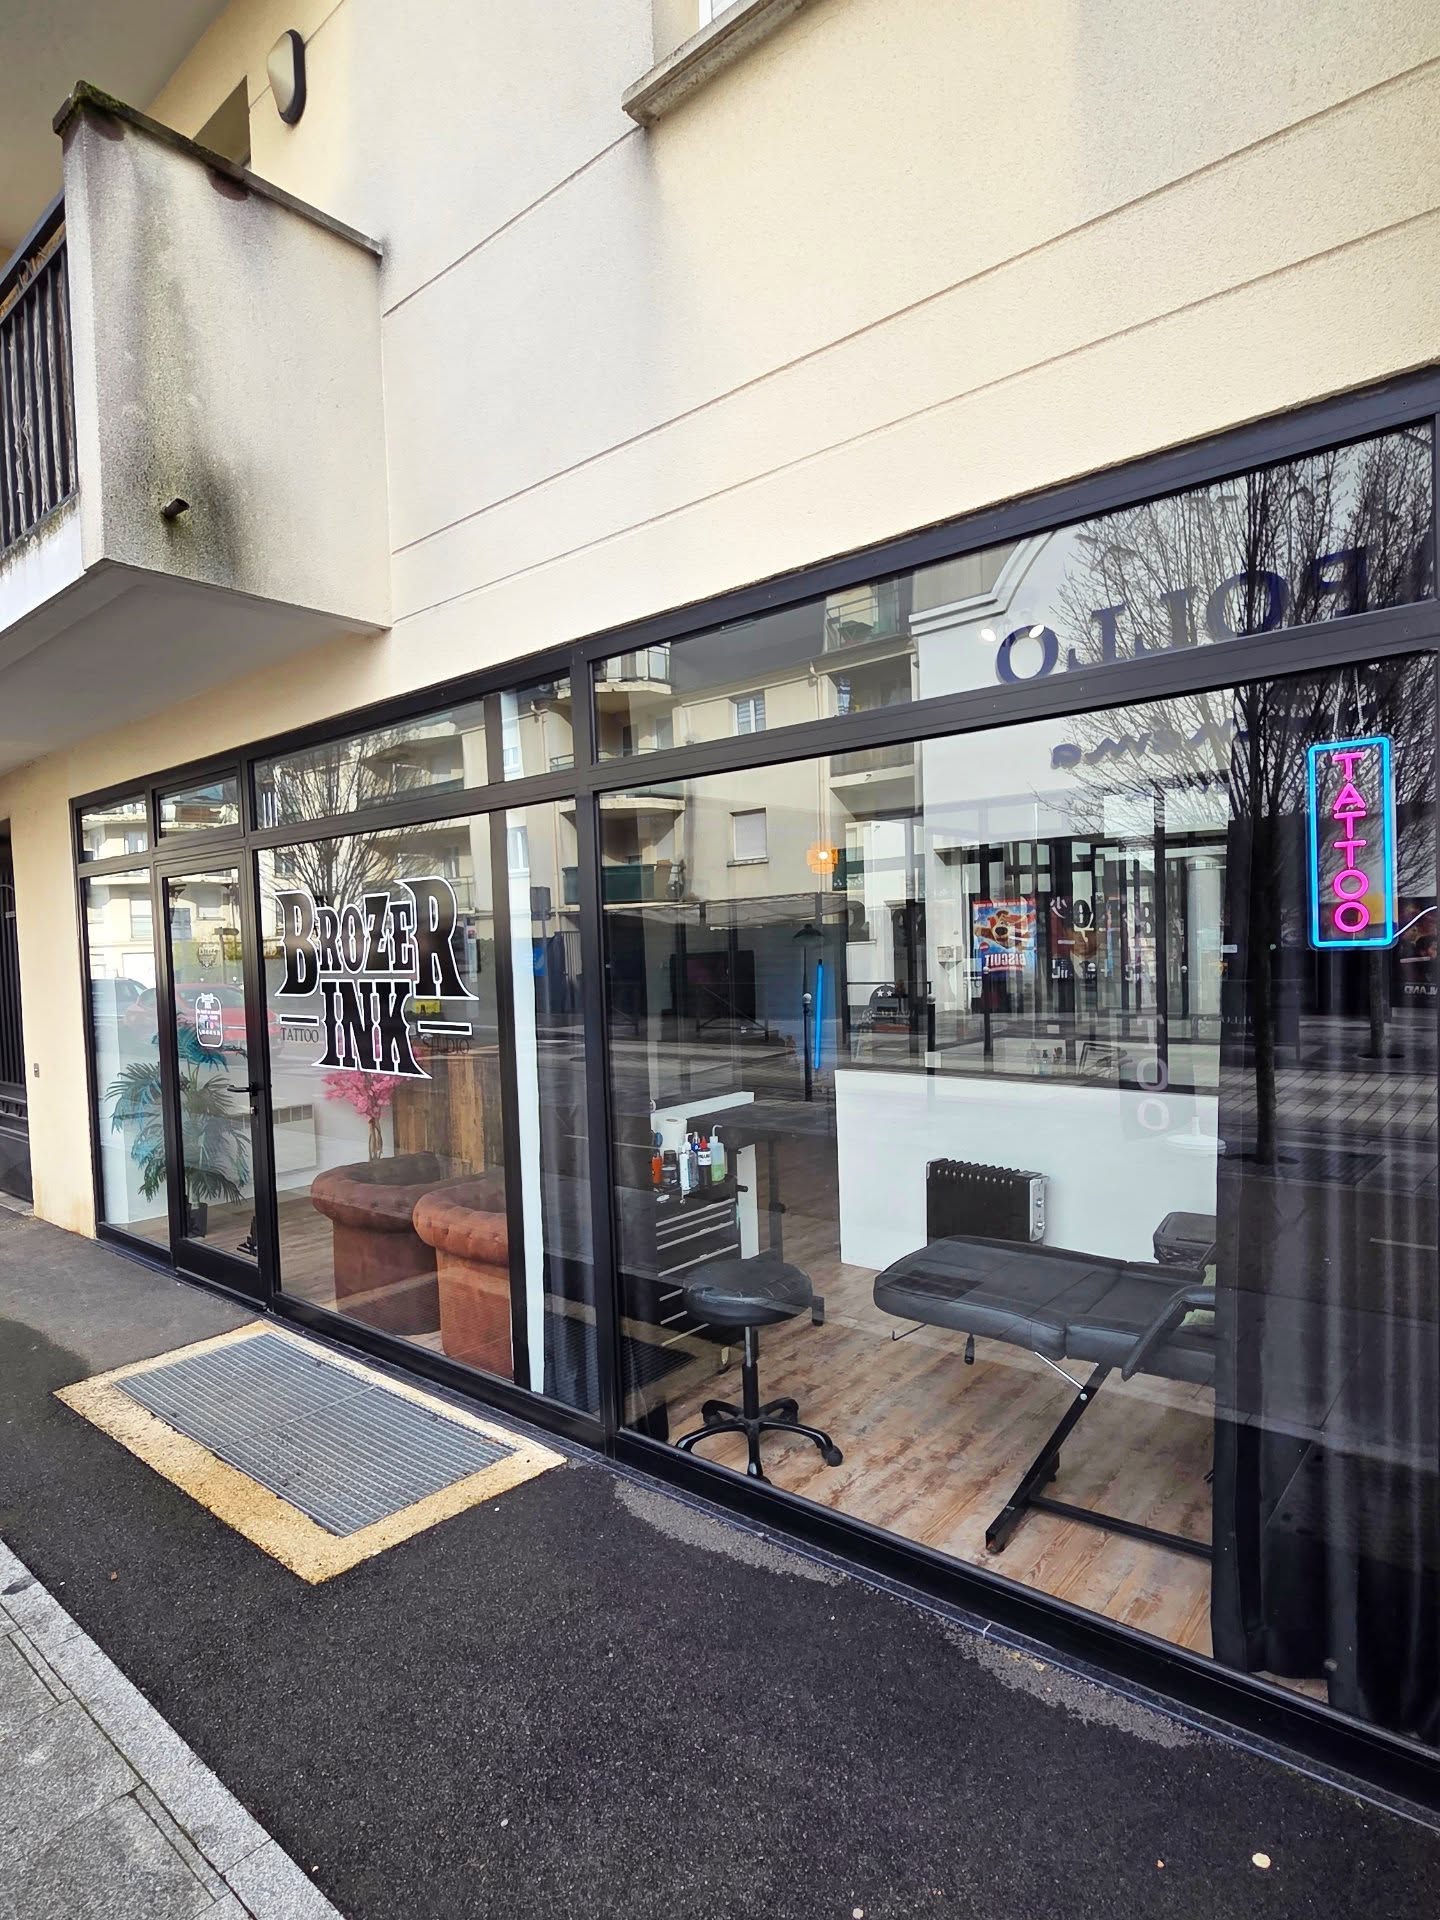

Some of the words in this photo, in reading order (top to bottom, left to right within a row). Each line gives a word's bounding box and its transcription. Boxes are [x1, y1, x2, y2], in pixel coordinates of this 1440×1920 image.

[1332, 751, 1369, 933] TATTOO
[274, 876, 480, 1001] BROZER
[280, 1026, 320, 1043] TATTOO
[311, 978, 433, 1080] INK
[421, 1035, 471, 1056] STUDIO
